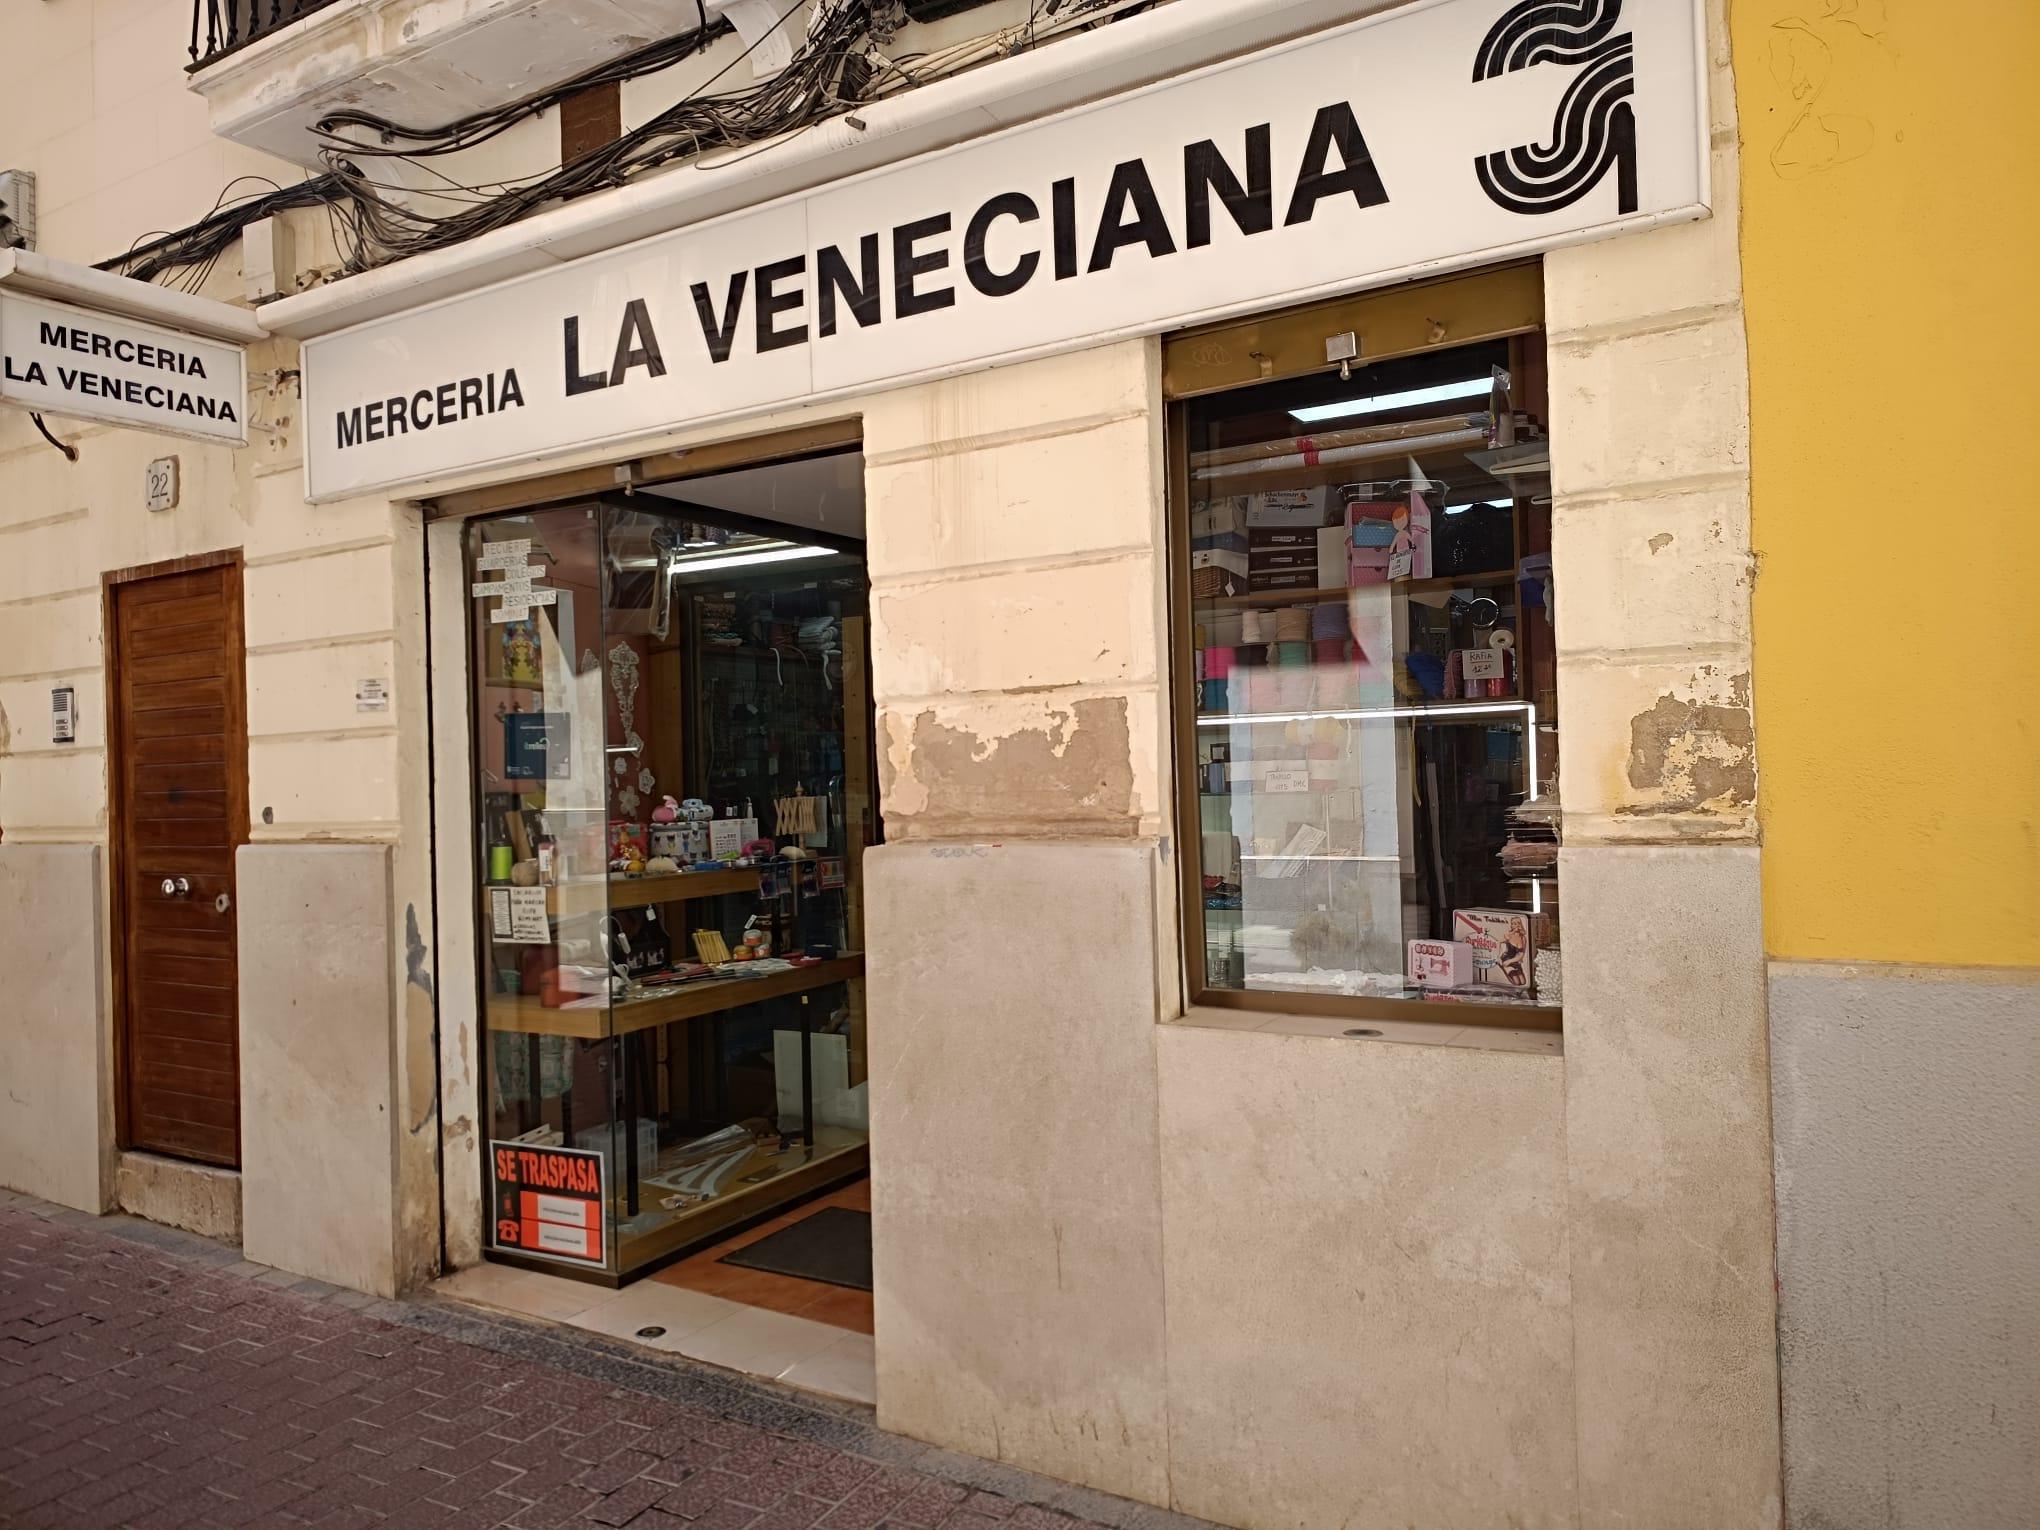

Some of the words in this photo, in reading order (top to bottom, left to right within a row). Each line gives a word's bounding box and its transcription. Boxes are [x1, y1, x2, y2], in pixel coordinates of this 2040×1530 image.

[336, 368, 525, 449] MERCERIA
[563, 298, 667, 397] LA
[689, 101, 1390, 364] VENECIANA
[40, 321, 207, 379] MERCERIA
[4, 355, 47, 387] LA
[57, 366, 237, 423] VENECIANA
[151, 472, 169, 499] 22
[496, 1149, 517, 1182] SE
[518, 1151, 599, 1193] TRASPASA
